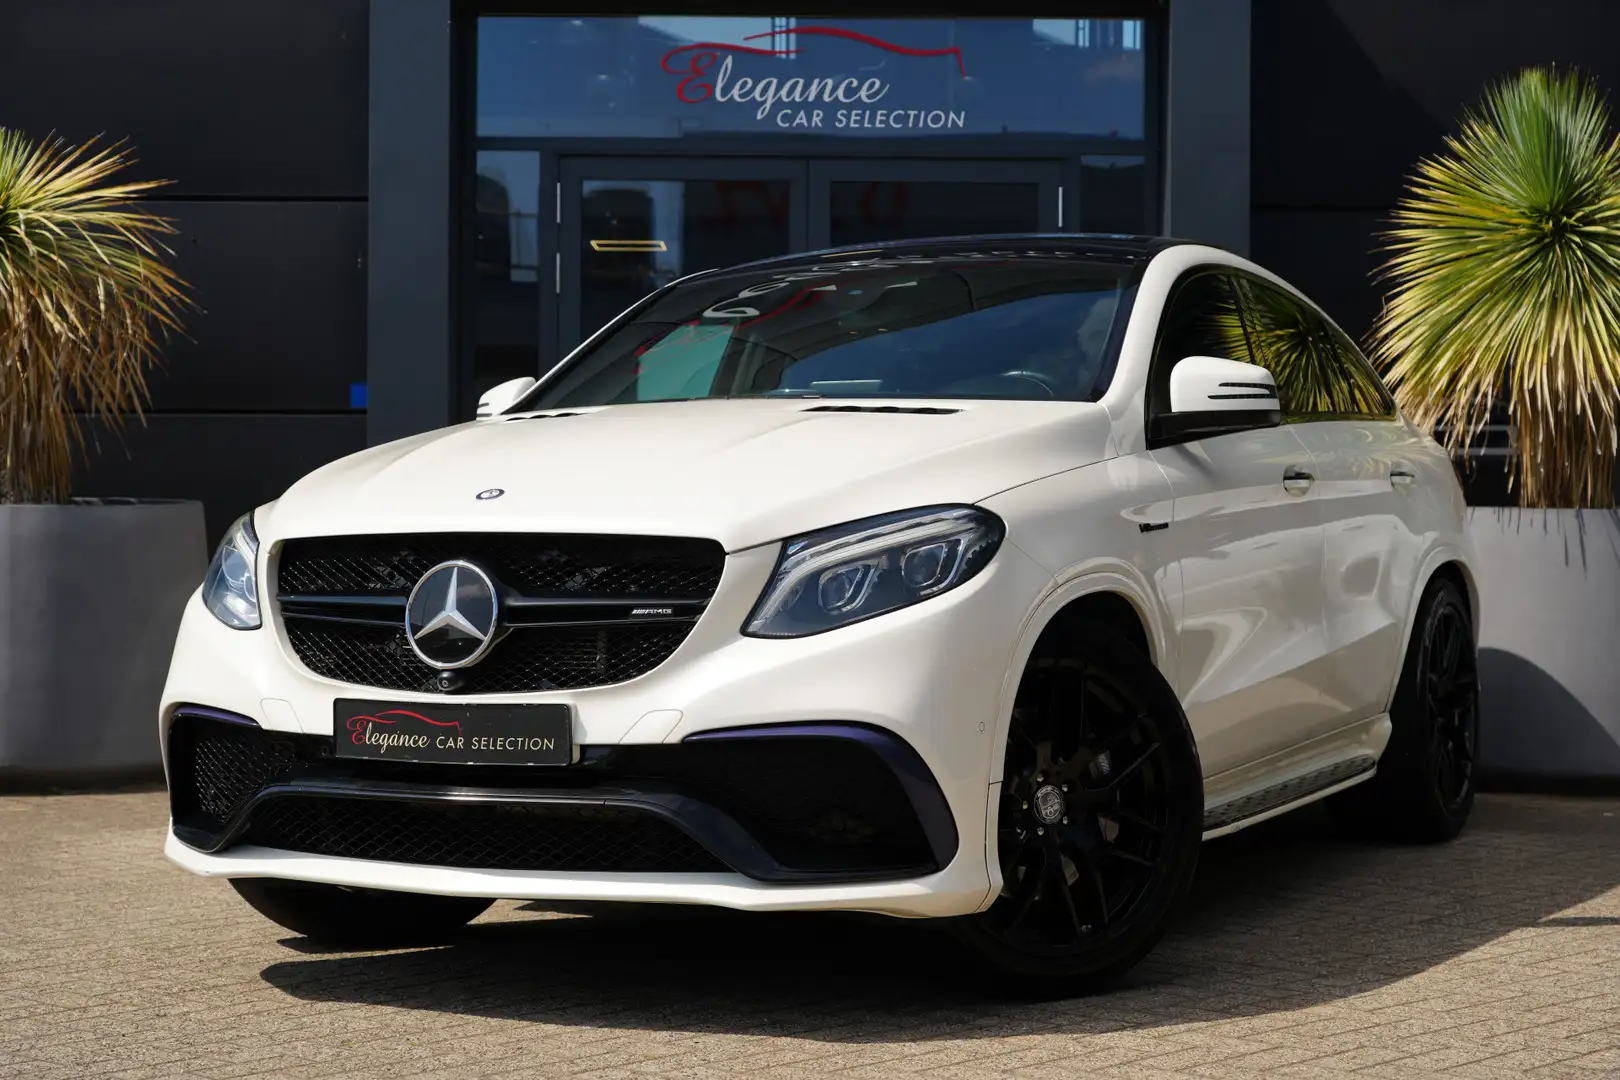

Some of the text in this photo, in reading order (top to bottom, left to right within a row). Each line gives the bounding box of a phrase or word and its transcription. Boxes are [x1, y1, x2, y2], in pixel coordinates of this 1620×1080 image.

[663, 48, 889, 120] Elegance
[776, 109, 966, 128] CAR SELECTION
[349, 718, 555, 753] Elegance CAR SELECTION
